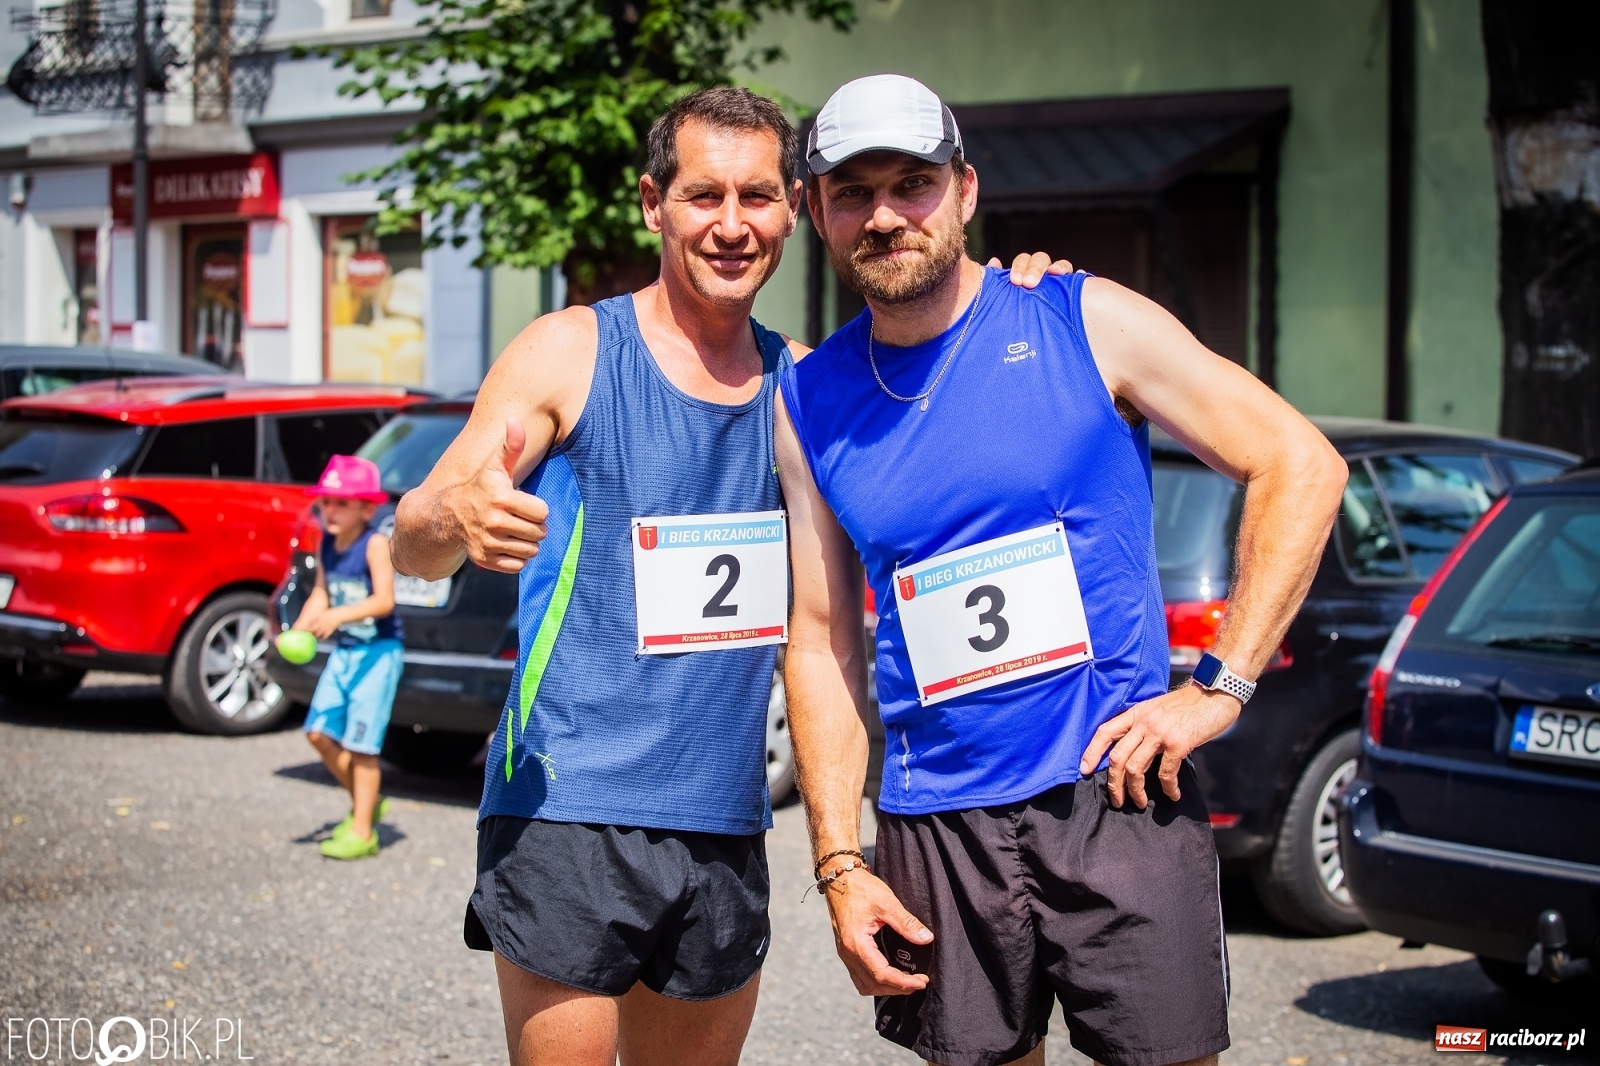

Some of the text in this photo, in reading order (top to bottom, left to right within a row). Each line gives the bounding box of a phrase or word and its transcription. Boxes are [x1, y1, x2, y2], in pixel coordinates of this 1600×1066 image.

[661, 525, 780, 544] I BIEG KRZANOWICKI
[702, 553, 740, 618] 2
[917, 539, 1057, 591] I BIEG KRZANOWICKI
[720, 632, 728, 640] 28
[729, 631, 742, 641] lipca
[743, 630, 755, 638] 2019
[965, 584, 1010, 653] 3
[956, 669, 994, 685] Krzanowice,
[995, 665, 1004, 674] 28
[1005, 662, 1022, 672] lipca
[1023, 655, 1042, 667] 2019
